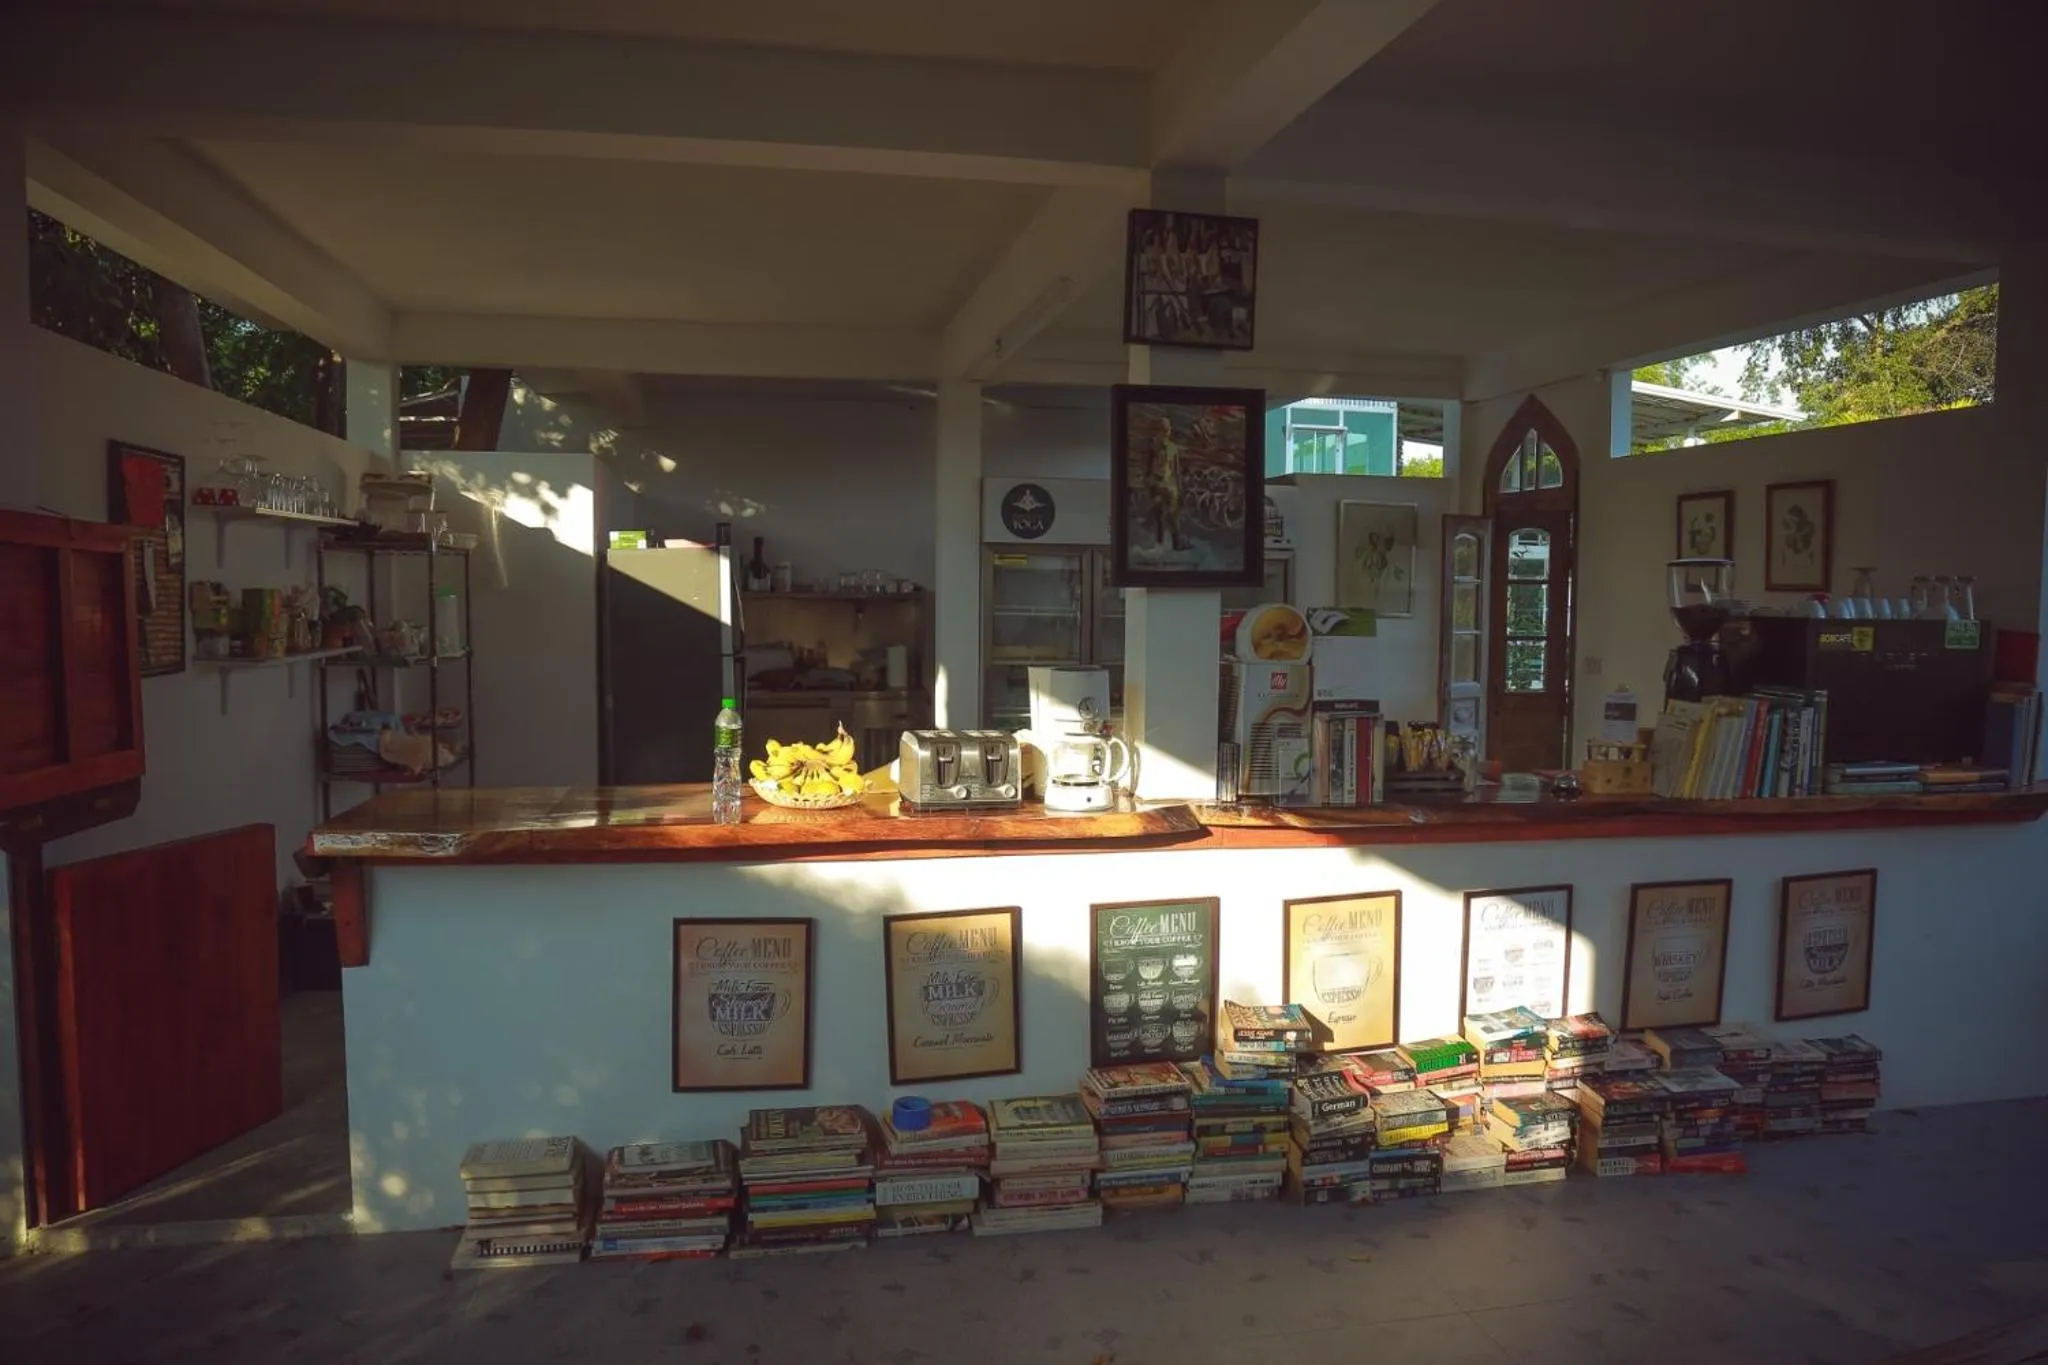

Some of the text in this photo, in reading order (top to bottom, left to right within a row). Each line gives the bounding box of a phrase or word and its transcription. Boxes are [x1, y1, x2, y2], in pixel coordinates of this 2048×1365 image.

[1272, 674, 1286, 688] illy
[1109, 911, 1197, 942] Coffee MENU
[1302, 908, 1383, 940] Coffee MENU
[696, 936, 791, 966] Coffee MENU
[906, 931, 953, 961] Coffee
[958, 927, 998, 950] MENU
[928, 985, 977, 1000] MILK
[717, 1004, 764, 1020] MILK
[1321, 1099, 1356, 1112] German
